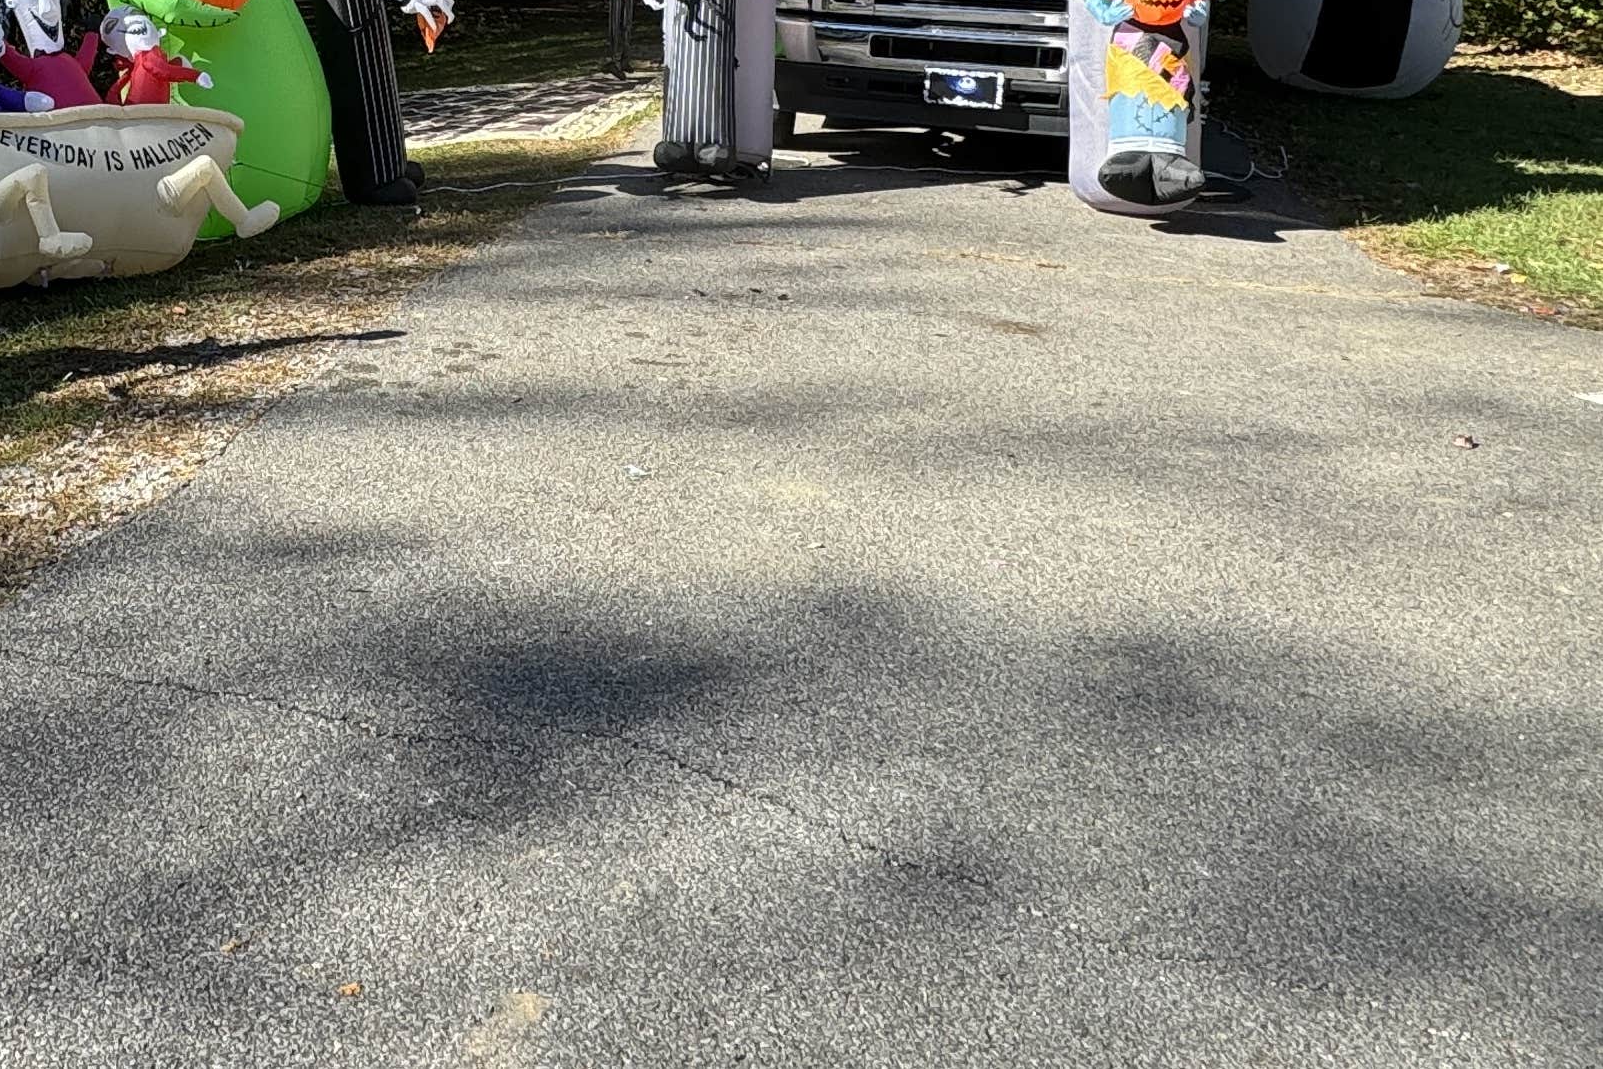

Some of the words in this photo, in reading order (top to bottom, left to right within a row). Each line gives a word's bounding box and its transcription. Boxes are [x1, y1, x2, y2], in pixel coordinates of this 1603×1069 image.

[0, 129, 96, 171] EVERYDAY
[105, 151, 125, 172] IS
[129, 122, 215, 171] HALLOWEEN
